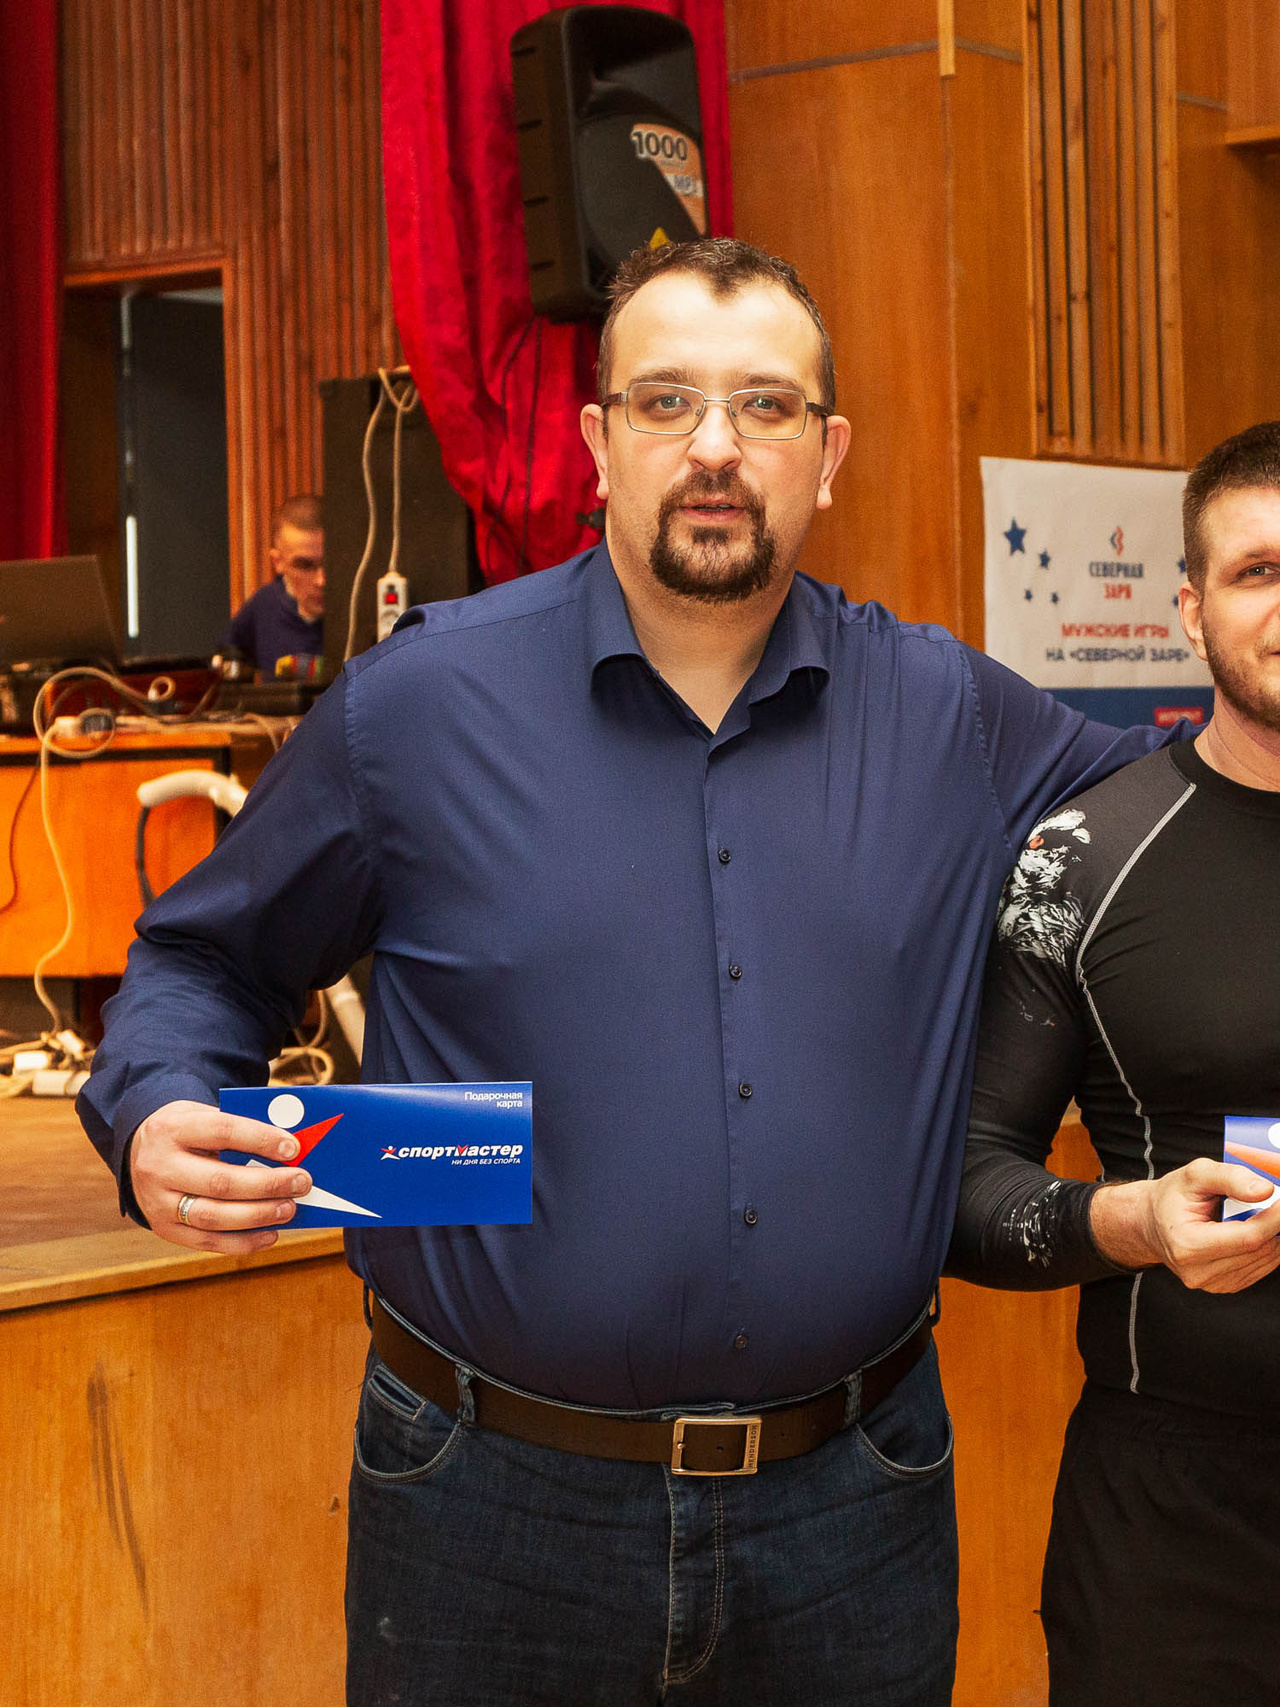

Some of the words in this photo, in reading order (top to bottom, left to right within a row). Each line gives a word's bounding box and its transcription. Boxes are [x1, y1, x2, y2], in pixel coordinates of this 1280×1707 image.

[632, 131, 688, 160] 1000
[1089, 561, 1144, 578] СЕВЕРНАЯ
[1061, 623, 1130, 638] МУЖСКИЕ
[1133, 624, 1170, 639] ИГРЫ
[1046, 648, 1065, 661] НА
[464, 1091, 523, 1101] Подарочная
[496, 1100, 523, 1109] карта
[463, 1158, 479, 1166] ДНЯ
[493, 1157, 521, 1165] СПОРТА
[748, 1424, 757, 1468] HENDERSON
